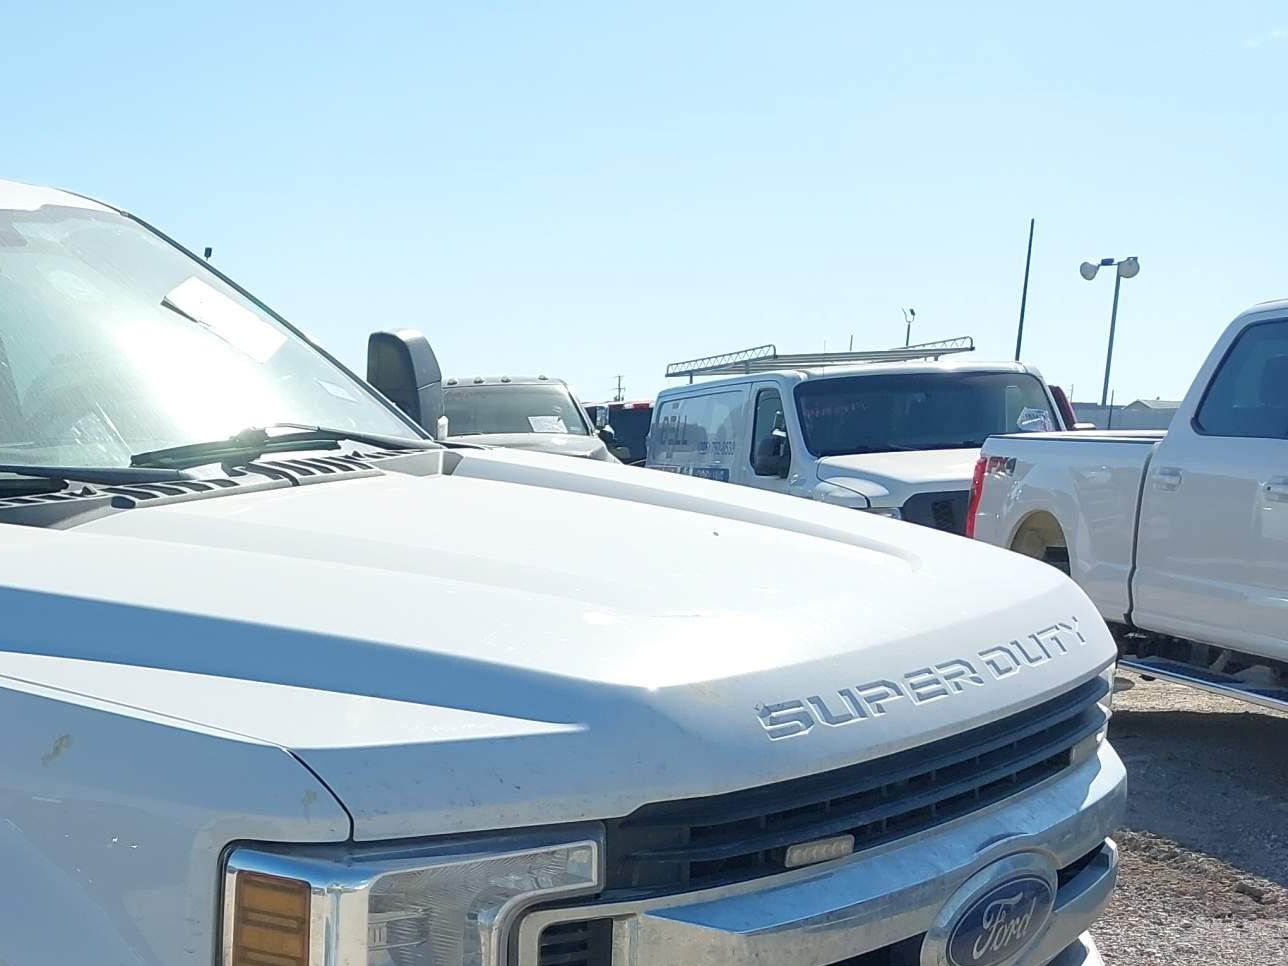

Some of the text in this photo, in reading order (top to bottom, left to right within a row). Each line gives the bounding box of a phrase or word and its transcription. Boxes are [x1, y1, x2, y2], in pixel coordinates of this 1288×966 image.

[753, 614, 1088, 741] SUPER DUTY
[971, 890, 1037, 961] Ford
